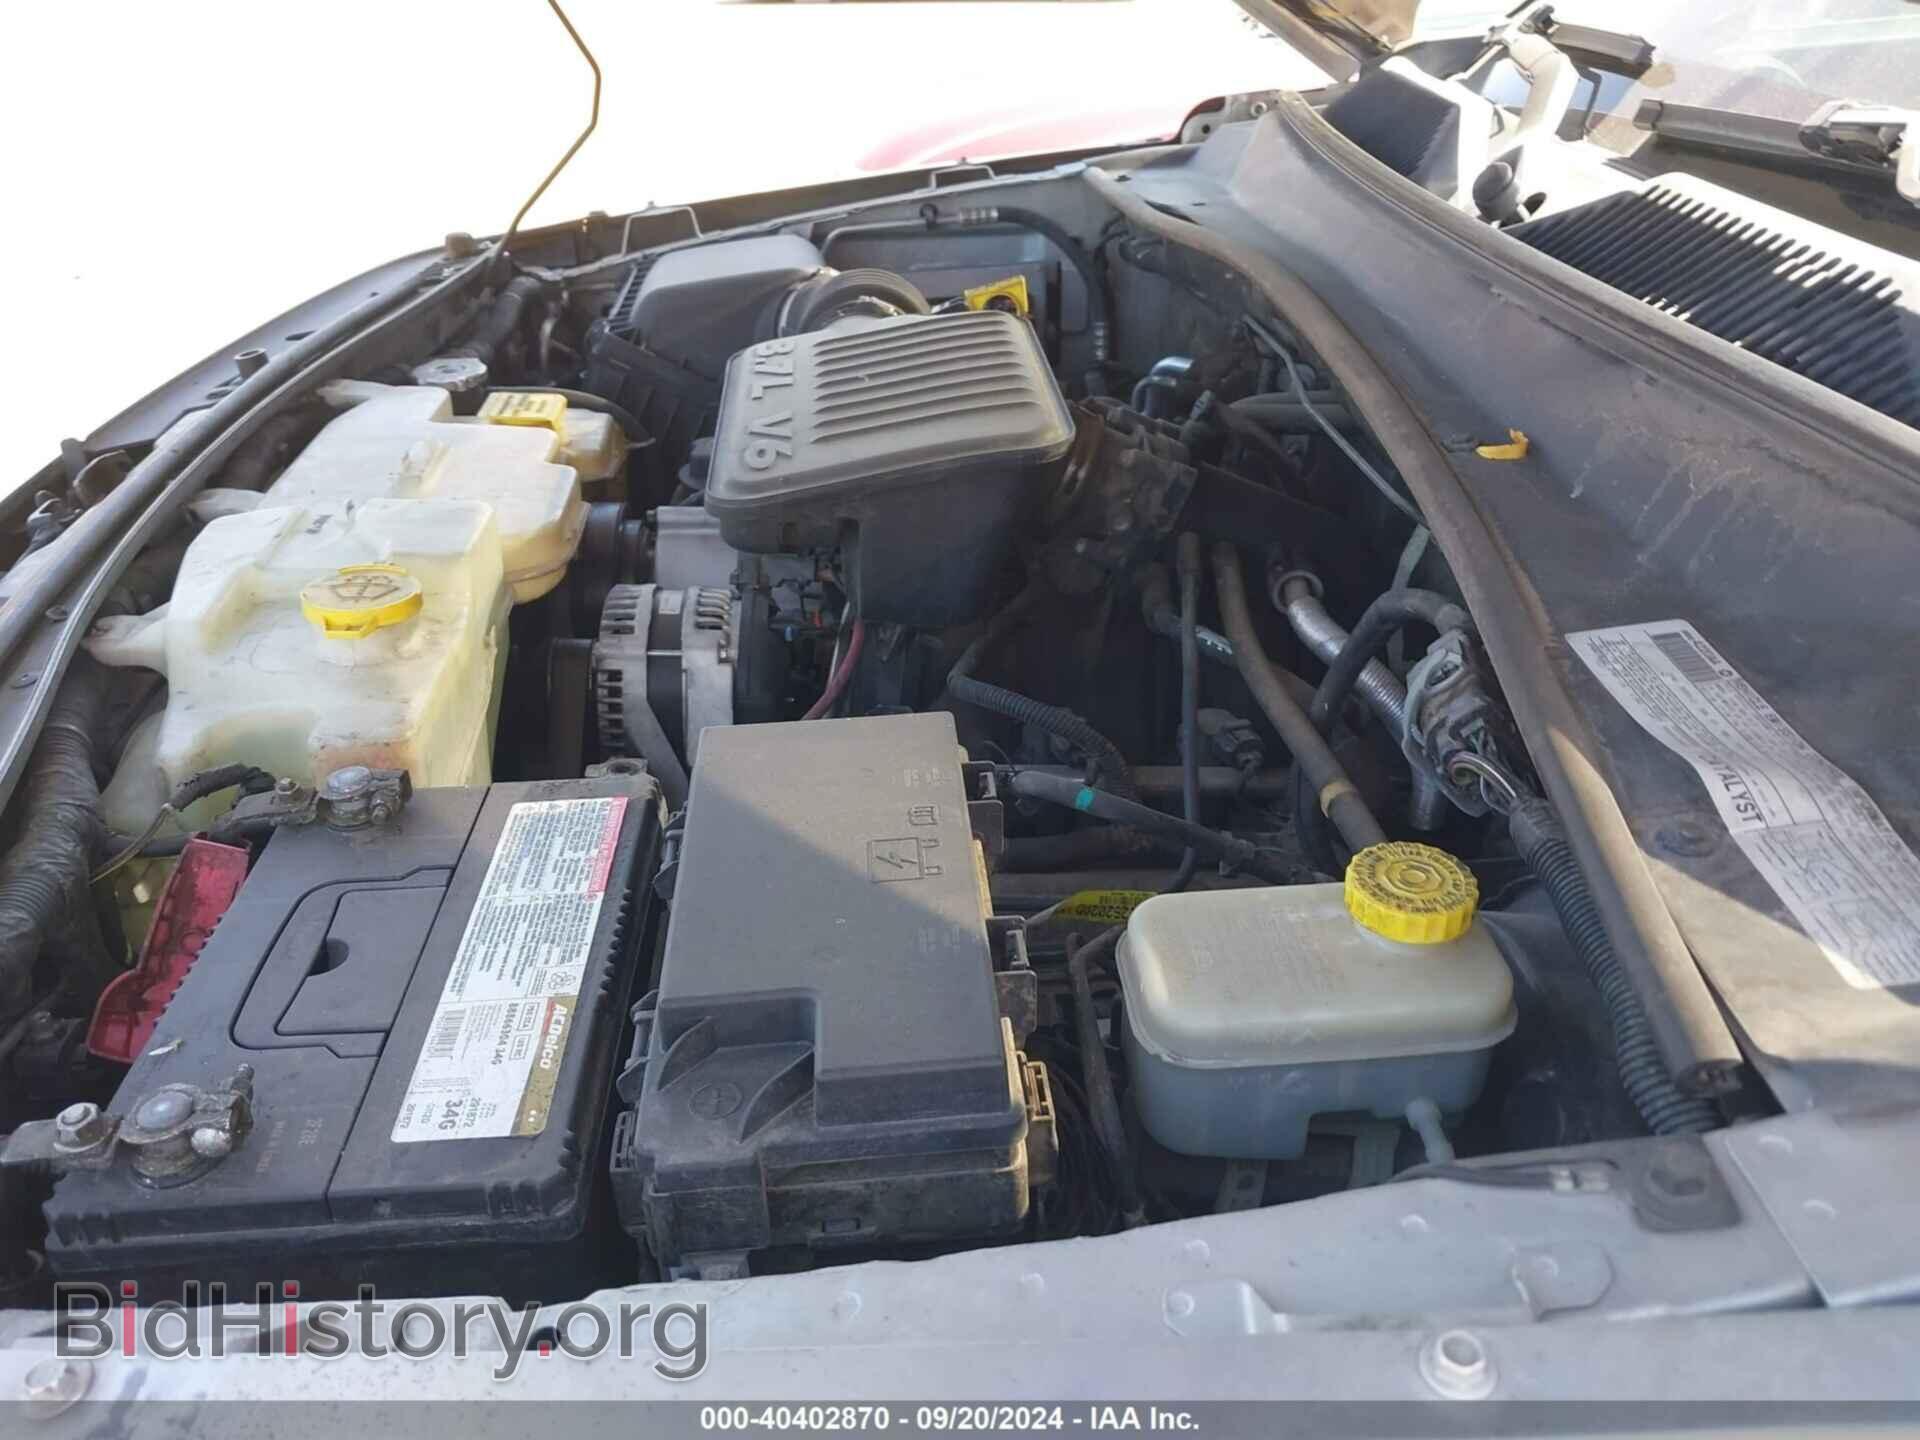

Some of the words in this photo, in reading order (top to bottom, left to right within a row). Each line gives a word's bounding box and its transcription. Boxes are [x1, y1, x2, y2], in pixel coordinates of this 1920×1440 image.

[751, 340, 793, 400] 3.7L
[743, 412, 793, 470] V6
[540, 1004, 567, 1069] ACDelco
[438, 1099, 463, 1130] 34G
